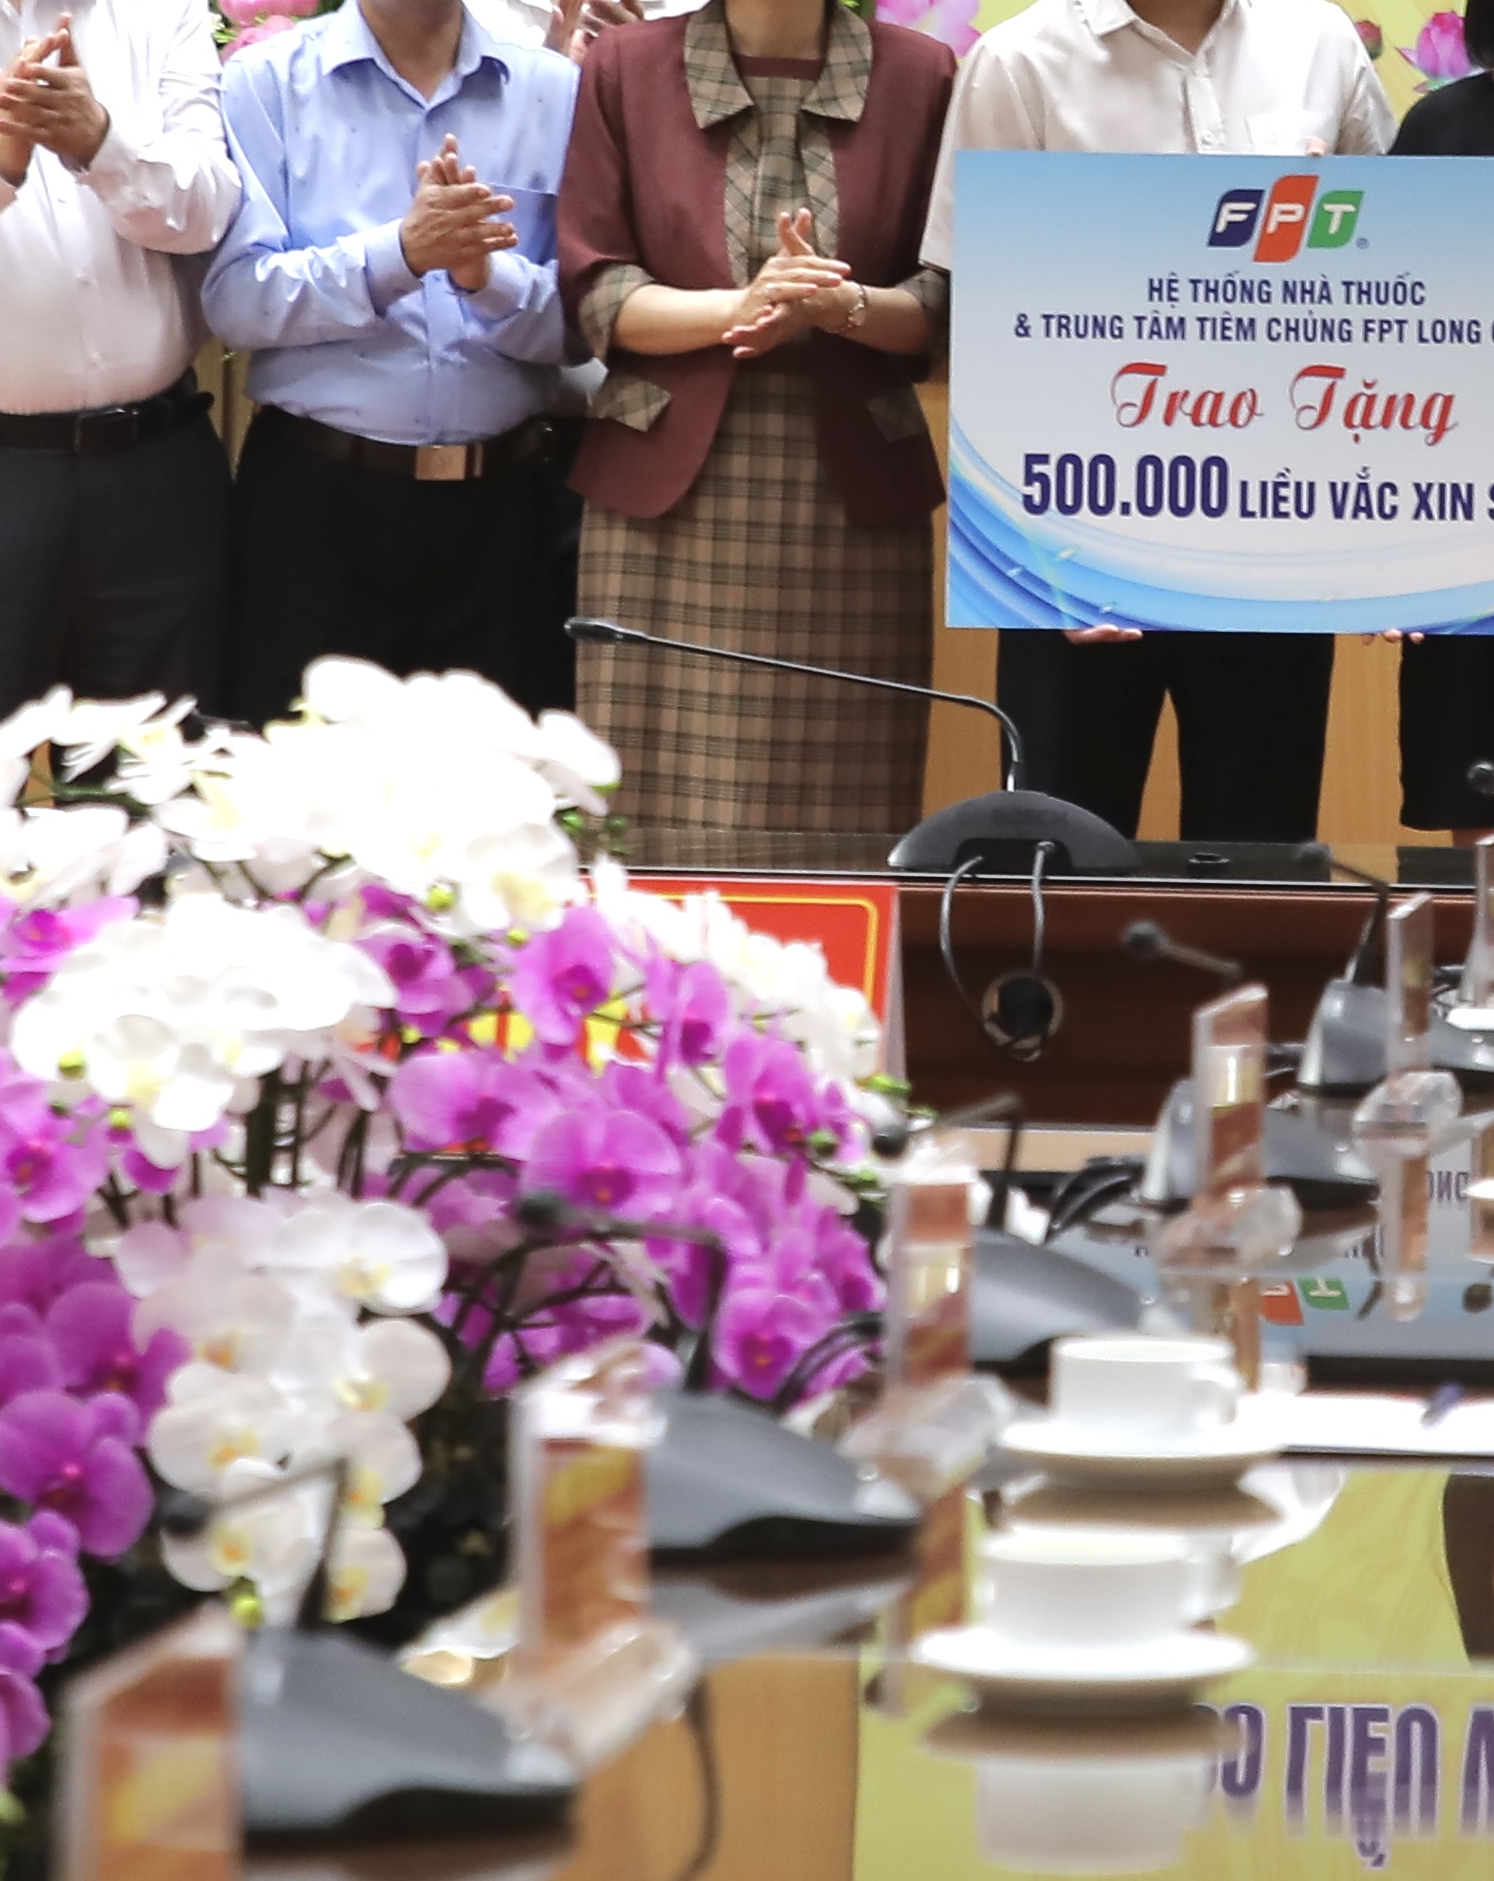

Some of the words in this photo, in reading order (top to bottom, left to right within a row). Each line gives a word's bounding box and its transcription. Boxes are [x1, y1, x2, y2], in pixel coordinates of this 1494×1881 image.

[1147, 272, 1180, 306] HỆ
[1188, 271, 1273, 306] THỐNG
[1282, 278, 1333, 306] NHÀ
[1341, 272, 1426, 307] THUỐC
[1014, 313, 1031, 339] &
[1042, 313, 1124, 341] TRUNG
[1133, 312, 1187, 342] TÂM
[1197, 313, 1257, 343] TIÊM
[1266, 313, 1353, 344] CHỦNG
[1362, 318, 1408, 344] FPT
[1418, 319, 1482, 345] LONG
[1110, 362, 1266, 429] Trao
[1290, 364, 1460, 446] Tặng
[1021, 452, 1229, 518] 500.000
[1239, 469, 1317, 519] LIỀU
[1330, 468, 1399, 520] VẮC
[1413, 483, 1475, 521] XIN
